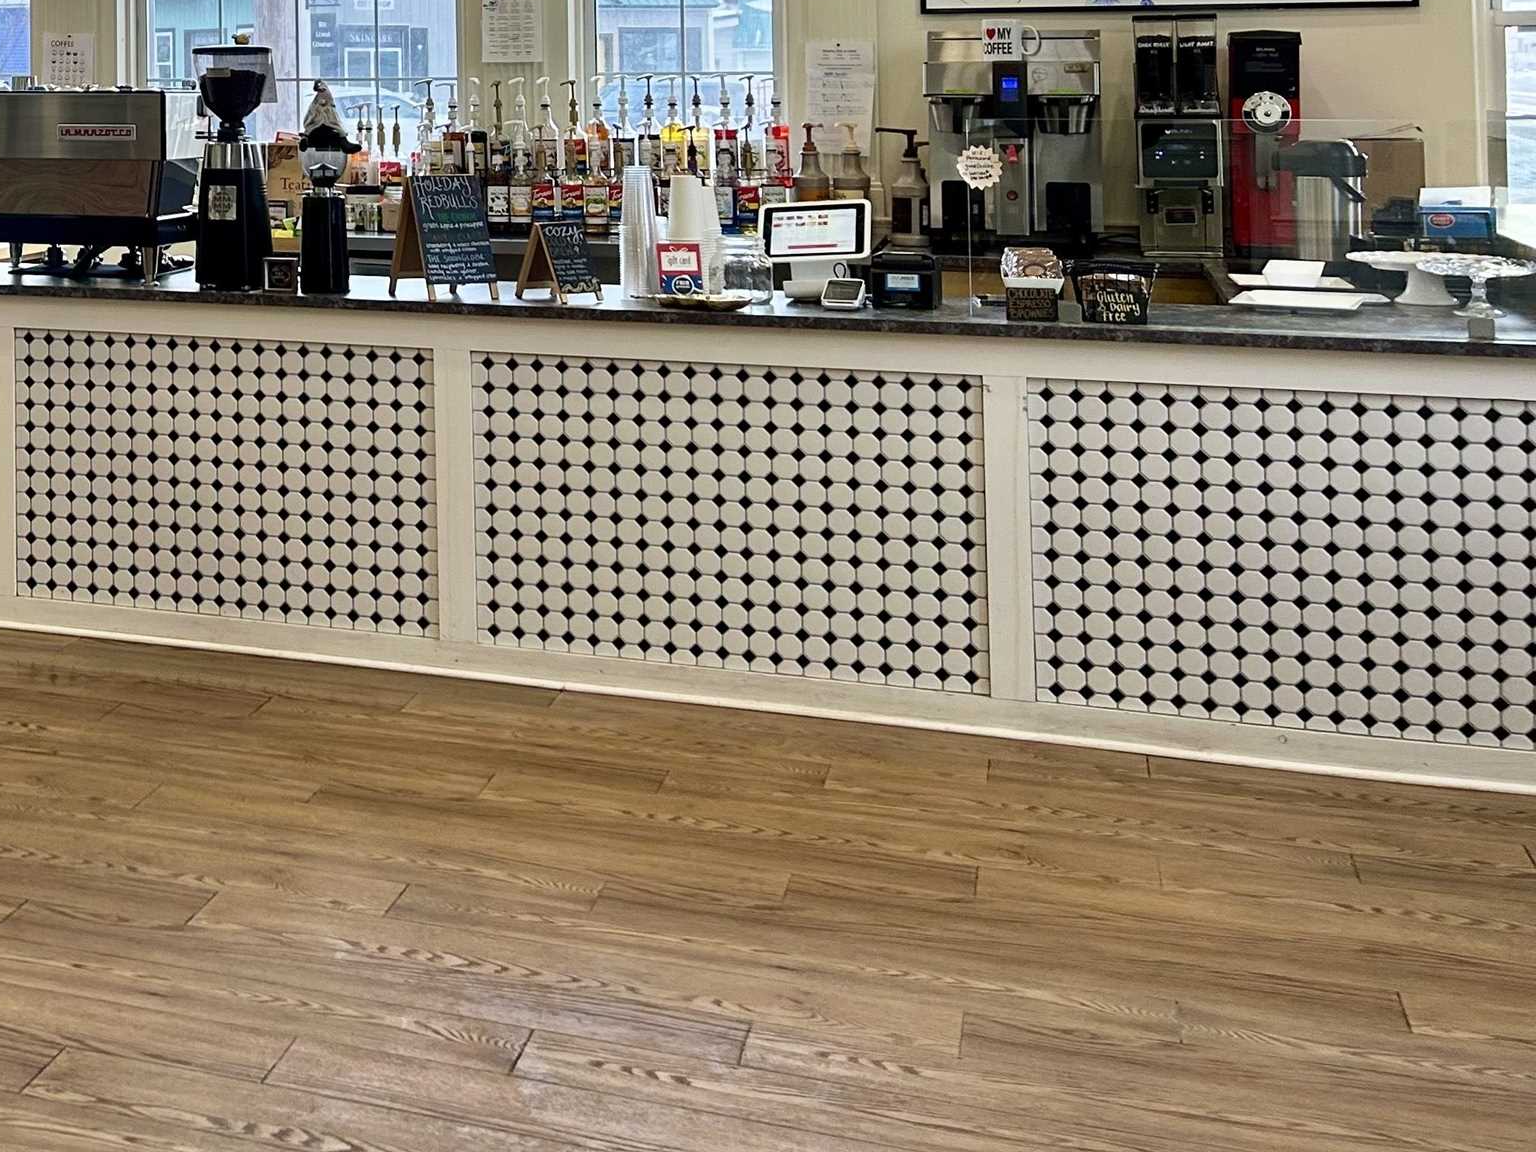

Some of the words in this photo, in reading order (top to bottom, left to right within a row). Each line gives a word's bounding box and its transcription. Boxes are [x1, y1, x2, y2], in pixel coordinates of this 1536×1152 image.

[997, 27, 1012, 40] MY
[984, 42, 1013, 55] COFFEE
[413, 176, 471, 198] HOLIDAY
[419, 193, 478, 221] REDBULLS
[1097, 290, 1134, 303] Gluten
[1110, 302, 1140, 316] Dairy
